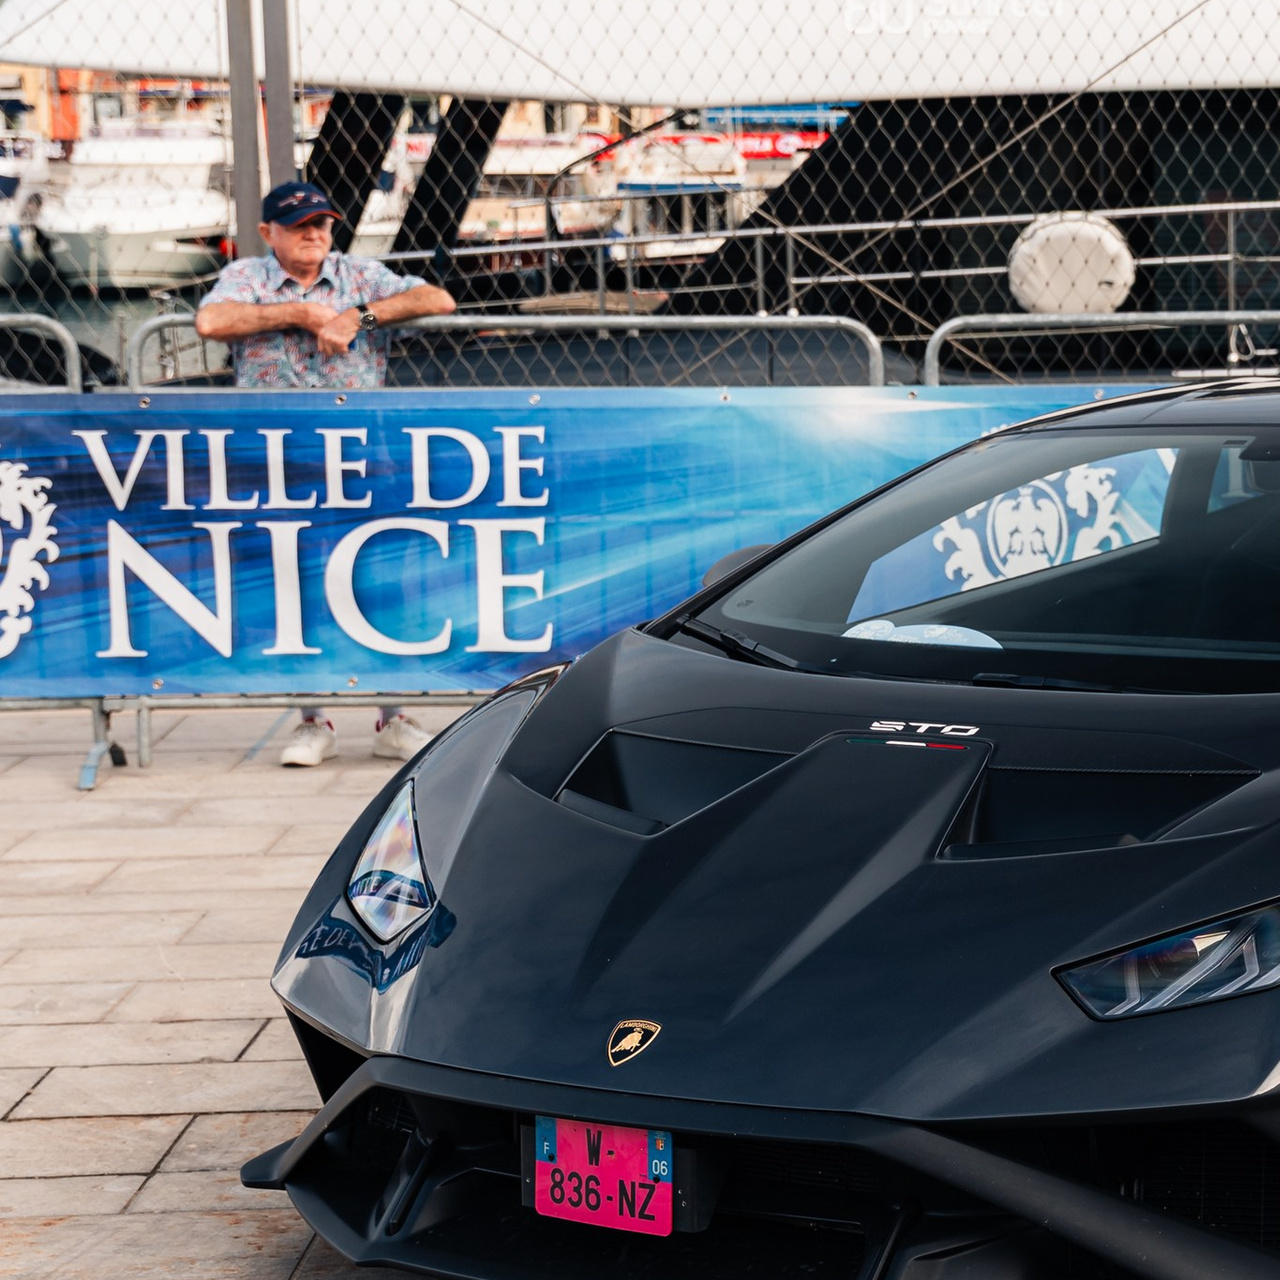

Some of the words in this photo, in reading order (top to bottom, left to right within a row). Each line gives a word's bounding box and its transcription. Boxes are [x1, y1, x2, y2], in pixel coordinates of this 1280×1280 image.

[72, 427, 372, 511] VILLE
[402, 425, 550, 509] DE
[96, 517, 553, 658] NICE
[869, 721, 980, 736] STO
[543, 1142, 550, 1155] F
[652, 1159, 668, 1176] 06
[550, 1168, 656, 1221] 836-NZ
